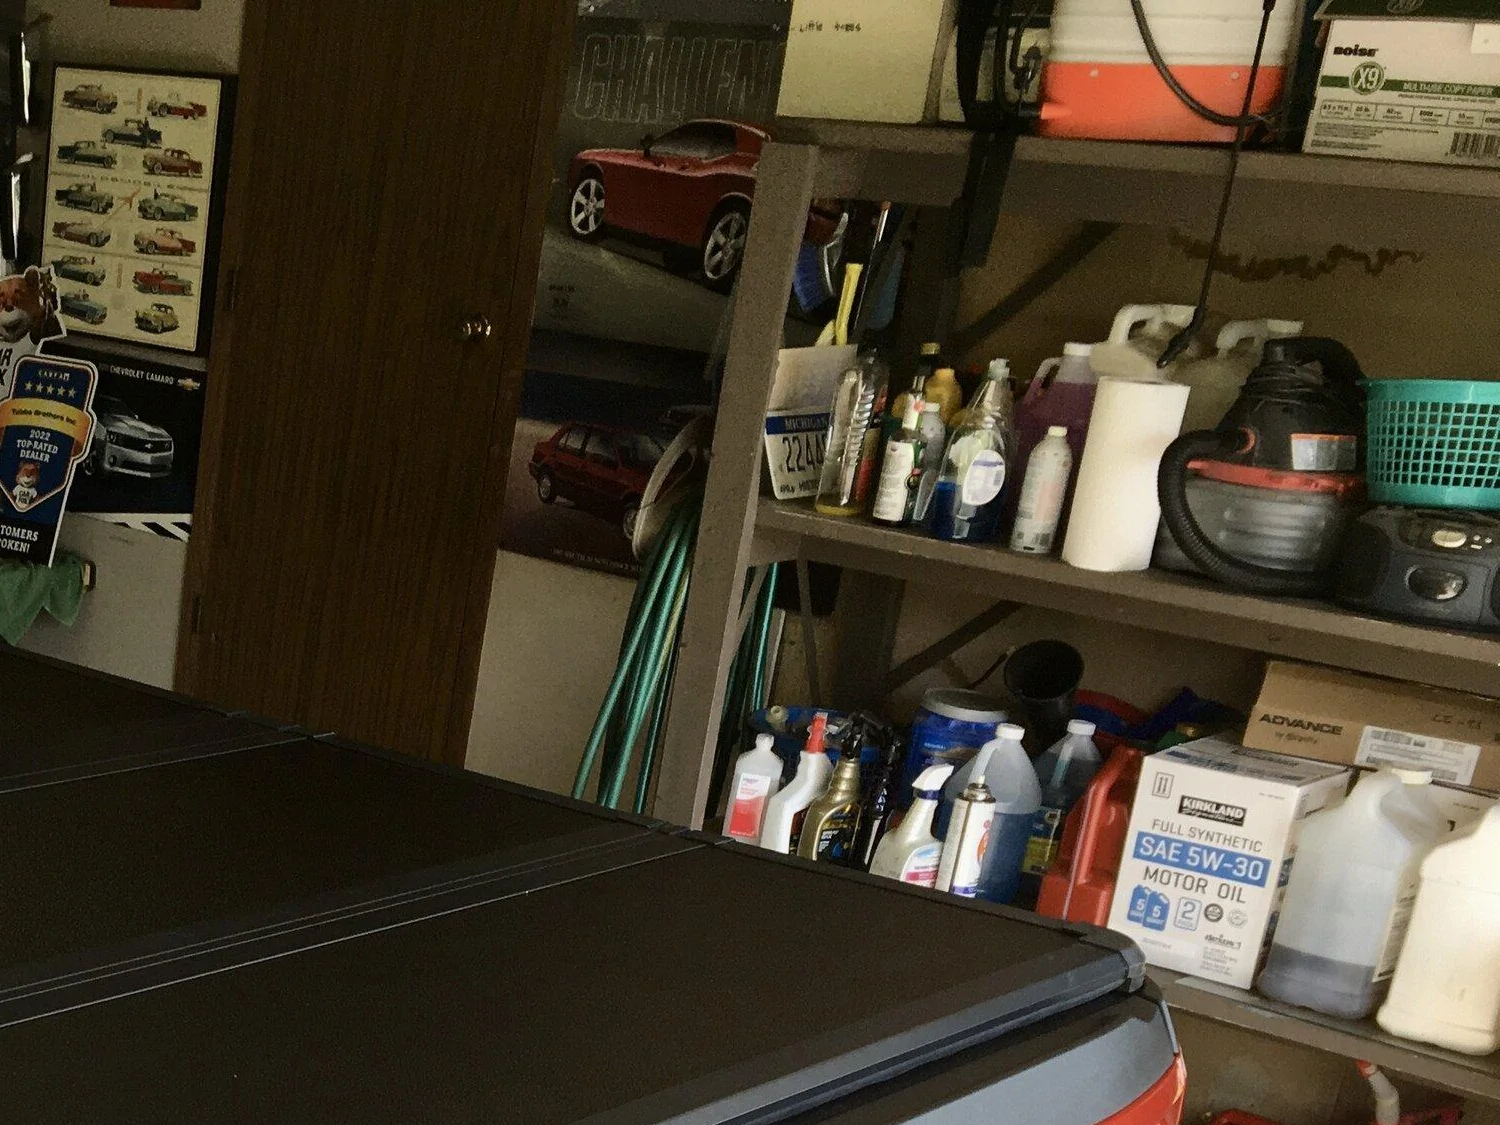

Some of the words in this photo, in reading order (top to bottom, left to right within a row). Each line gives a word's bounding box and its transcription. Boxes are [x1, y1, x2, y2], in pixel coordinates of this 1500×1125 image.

[574, 33, 785, 124] CHALLEN
[1356, 67, 1379, 90] X9
[109, 365, 144, 380] CHEVROLET
[146, 372, 174, 385] CAMARO
[785, 416, 827, 431] MICHIGA
[29, 430, 51, 442] 2022
[19, 450, 51, 464] DEALER
[1260, 713, 1344, 736] ADVANCE
[1182, 797, 1245, 819] KIRKLAND
[1152, 818, 1184, 836] FULL
[1188, 826, 1263, 853] SYNTHETIC
[1139, 836, 1181, 863] SAE
[1186, 846, 1264, 881] 5W-30
[1143, 865, 1208, 894] MOTOR
[1217, 882, 1246, 904] OIL
[1136, 899, 1145, 911] 5
[1152, 905, 1161, 918] 5
[1183, 901, 1197, 921] 2
